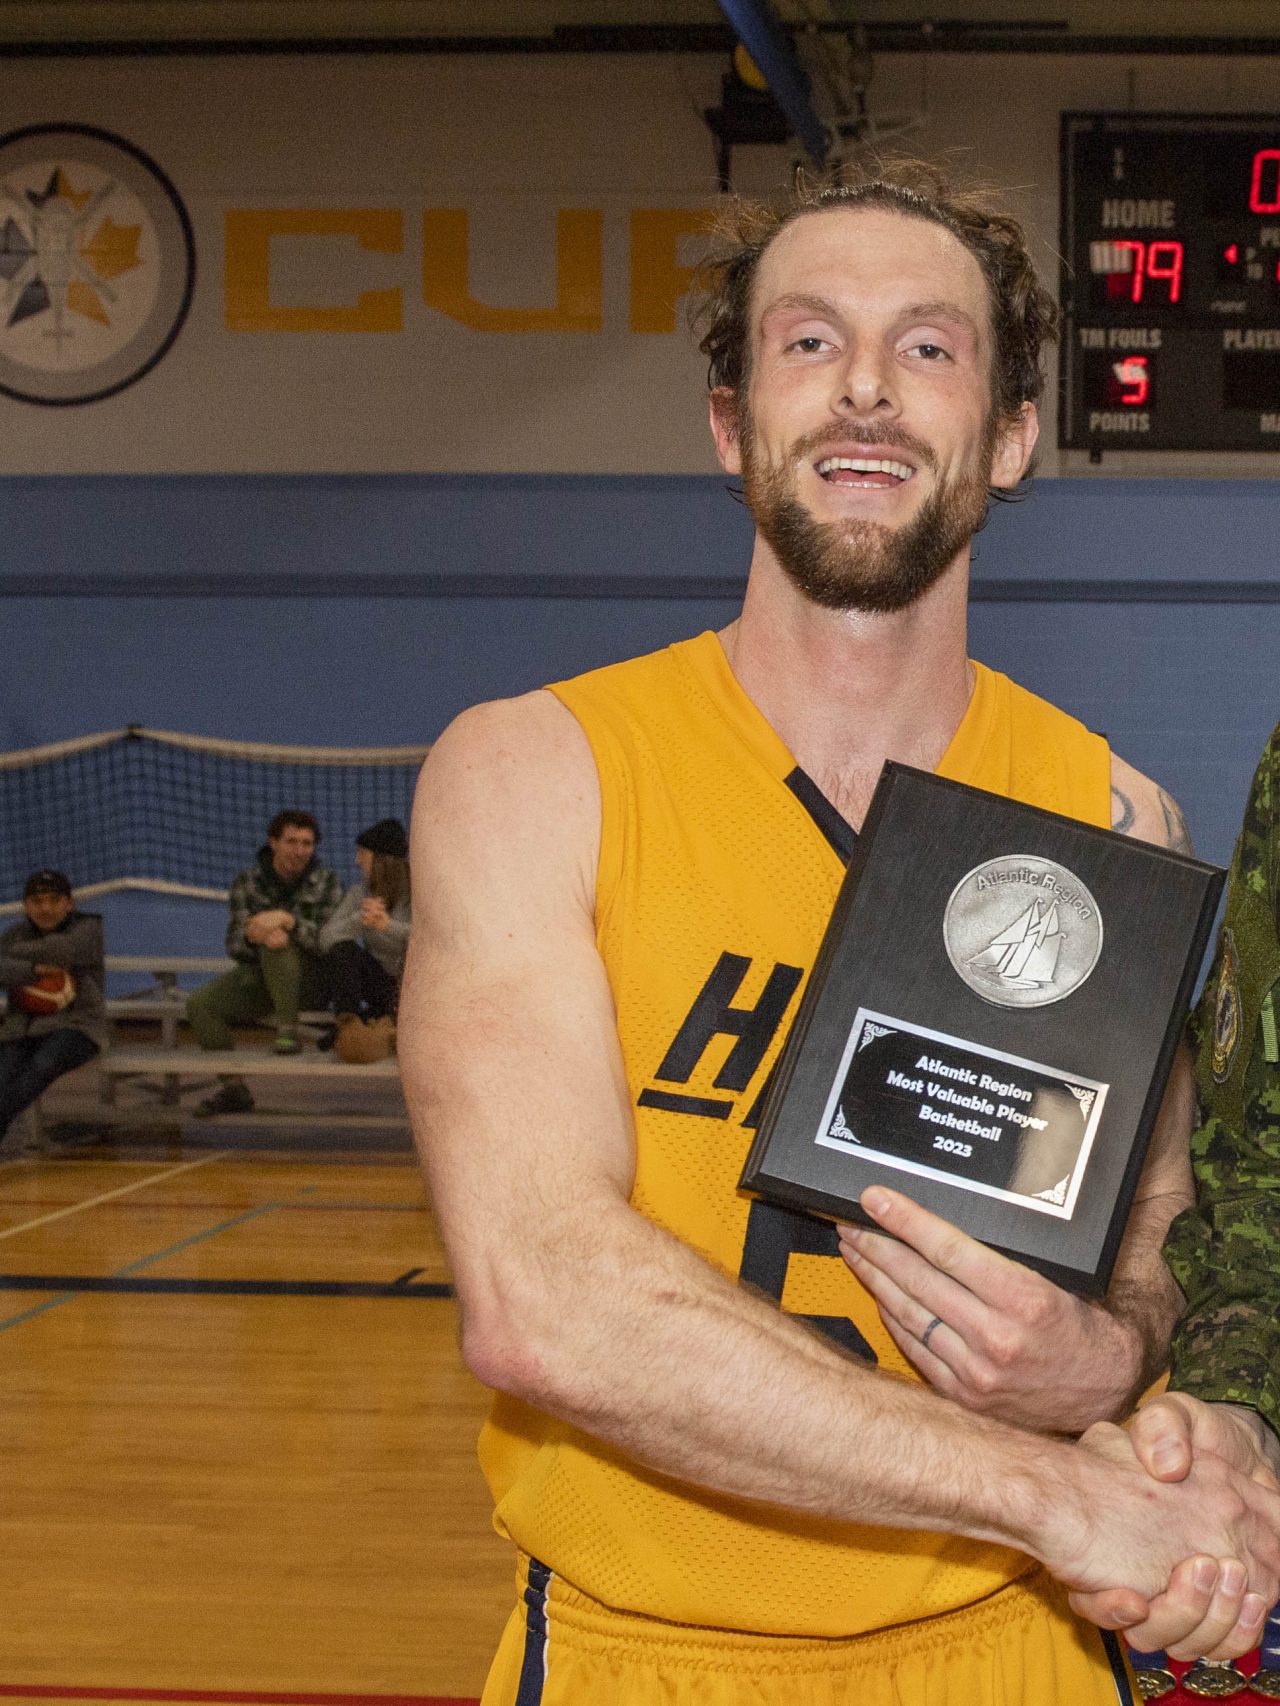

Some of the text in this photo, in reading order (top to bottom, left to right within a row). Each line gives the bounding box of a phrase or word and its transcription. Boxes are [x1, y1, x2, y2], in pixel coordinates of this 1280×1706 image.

[1102, 200, 1176, 229] HOME
[1109, 328, 1163, 349] FOULS
[1089, 412, 1151, 433] POINTS
[975, 868, 1092, 920] Atlantic Region
[914, 1055, 1034, 1103] Atlantic Region
[886, 1070, 1049, 1132] Most Valuable Player
[918, 1104, 1003, 1143] Basketball
[932, 1135, 974, 1158] 2023
